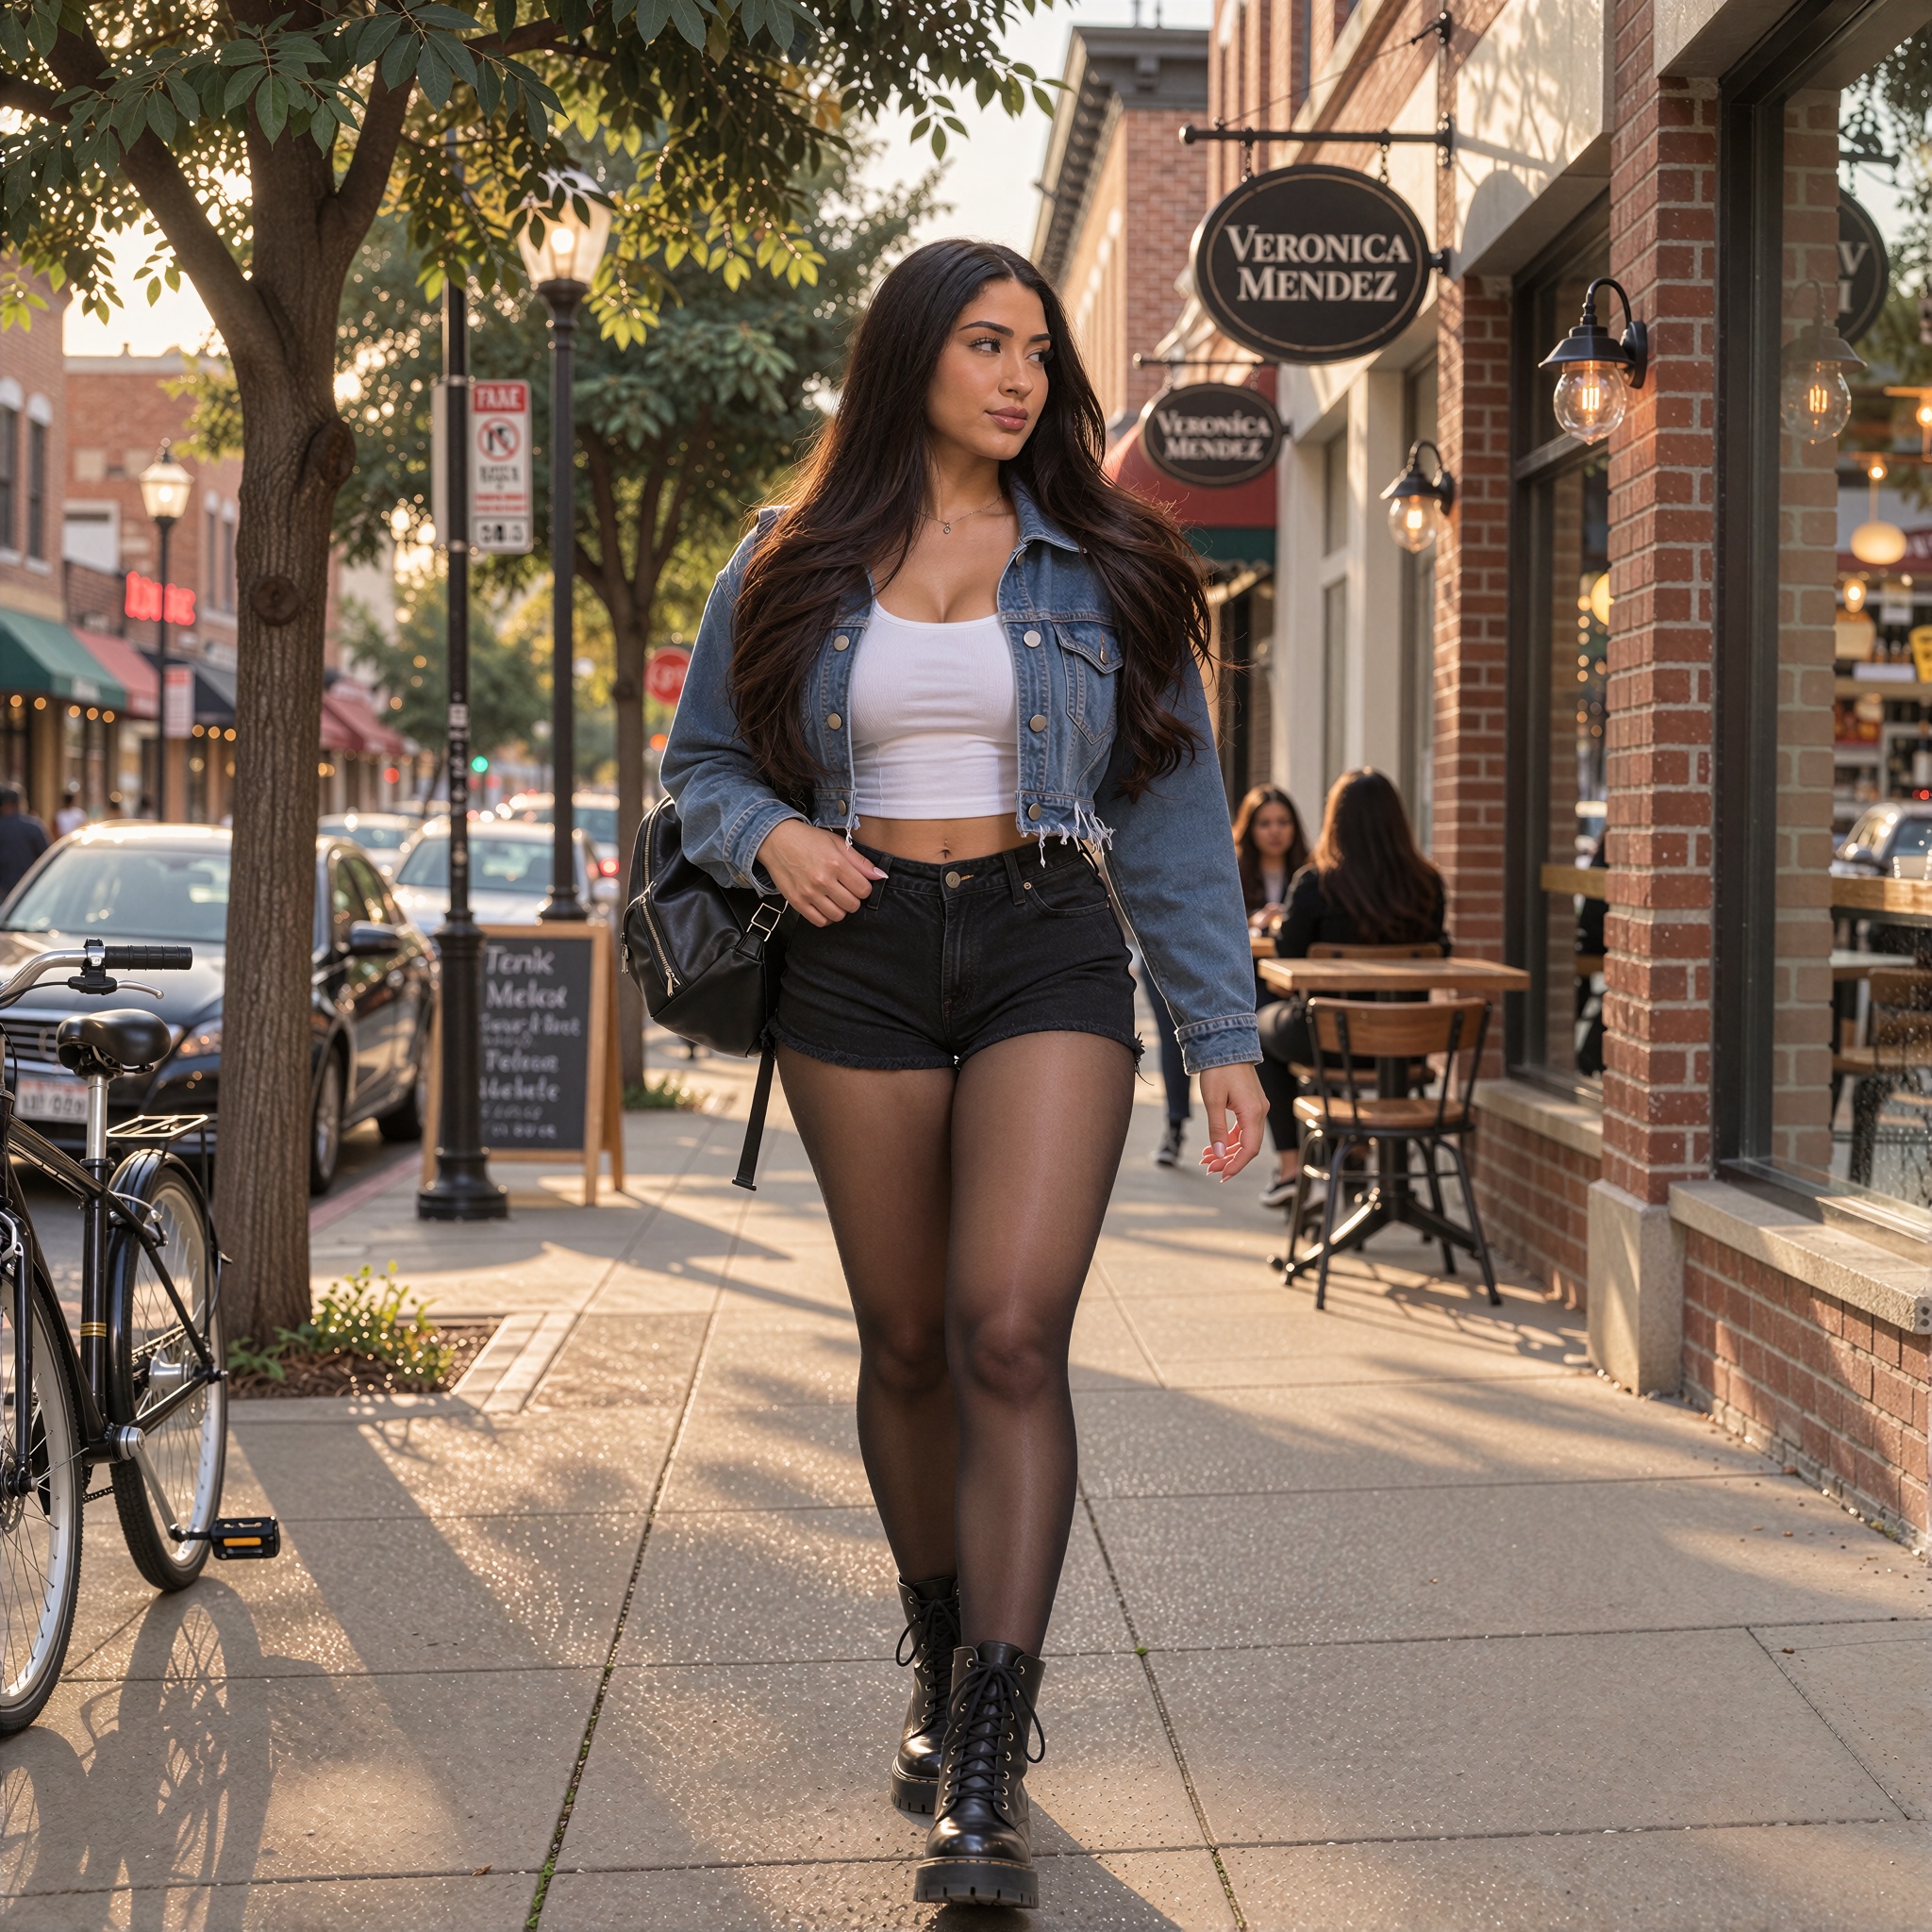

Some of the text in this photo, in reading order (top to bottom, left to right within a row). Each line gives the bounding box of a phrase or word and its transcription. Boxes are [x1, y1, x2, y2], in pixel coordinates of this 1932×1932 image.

[1224, 224, 1412, 264] VERONICA
[1236, 265, 1398, 303] MENDEZ
[1164, 437, 1265, 460] MENDEZ
